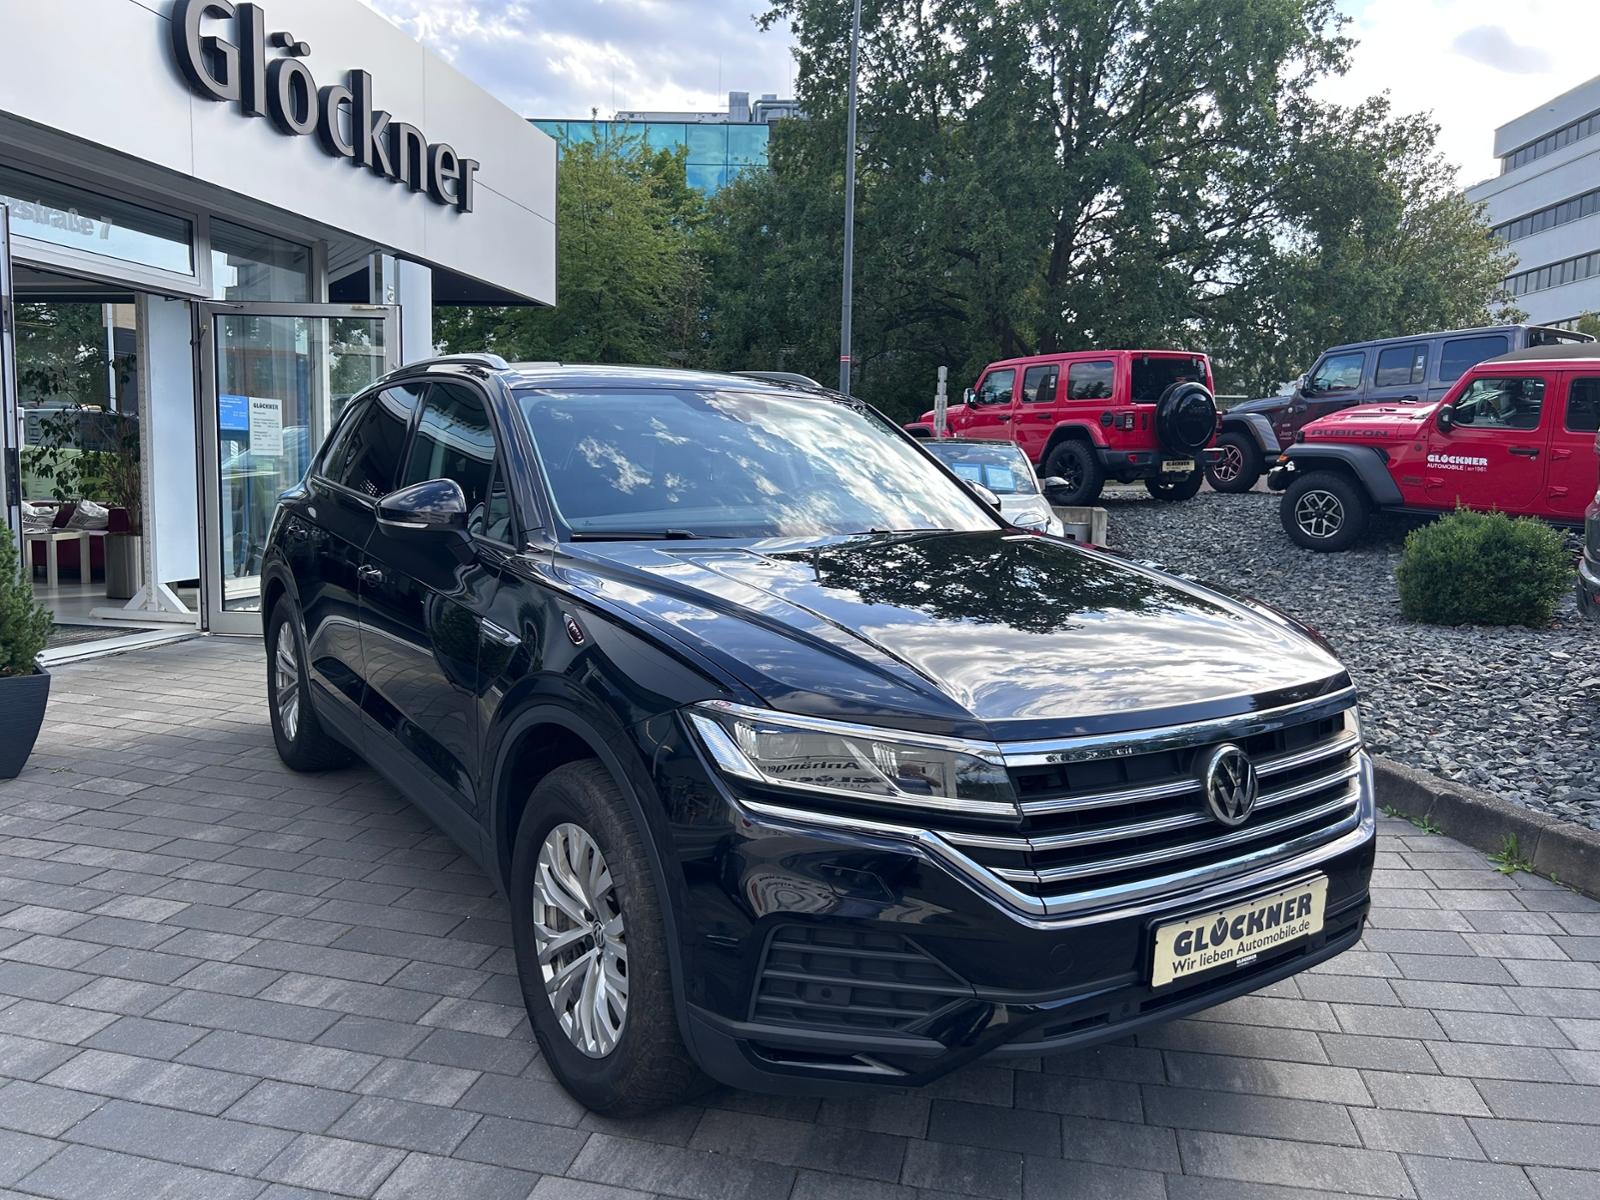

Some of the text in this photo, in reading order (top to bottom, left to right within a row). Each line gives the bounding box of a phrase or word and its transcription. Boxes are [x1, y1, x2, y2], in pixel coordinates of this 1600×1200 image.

[172, 0, 480, 213] Glöckner
[4, 196, 112, 240] zstraße 7
[1311, 429, 1389, 438] RUBICON
[1427, 463, 1464, 471] AUTOMOBILE
[1172, 958, 1197, 974] Wir
[1200, 948, 1233, 967] lieben
[1236, 920, 1310, 955] Automobile.de
